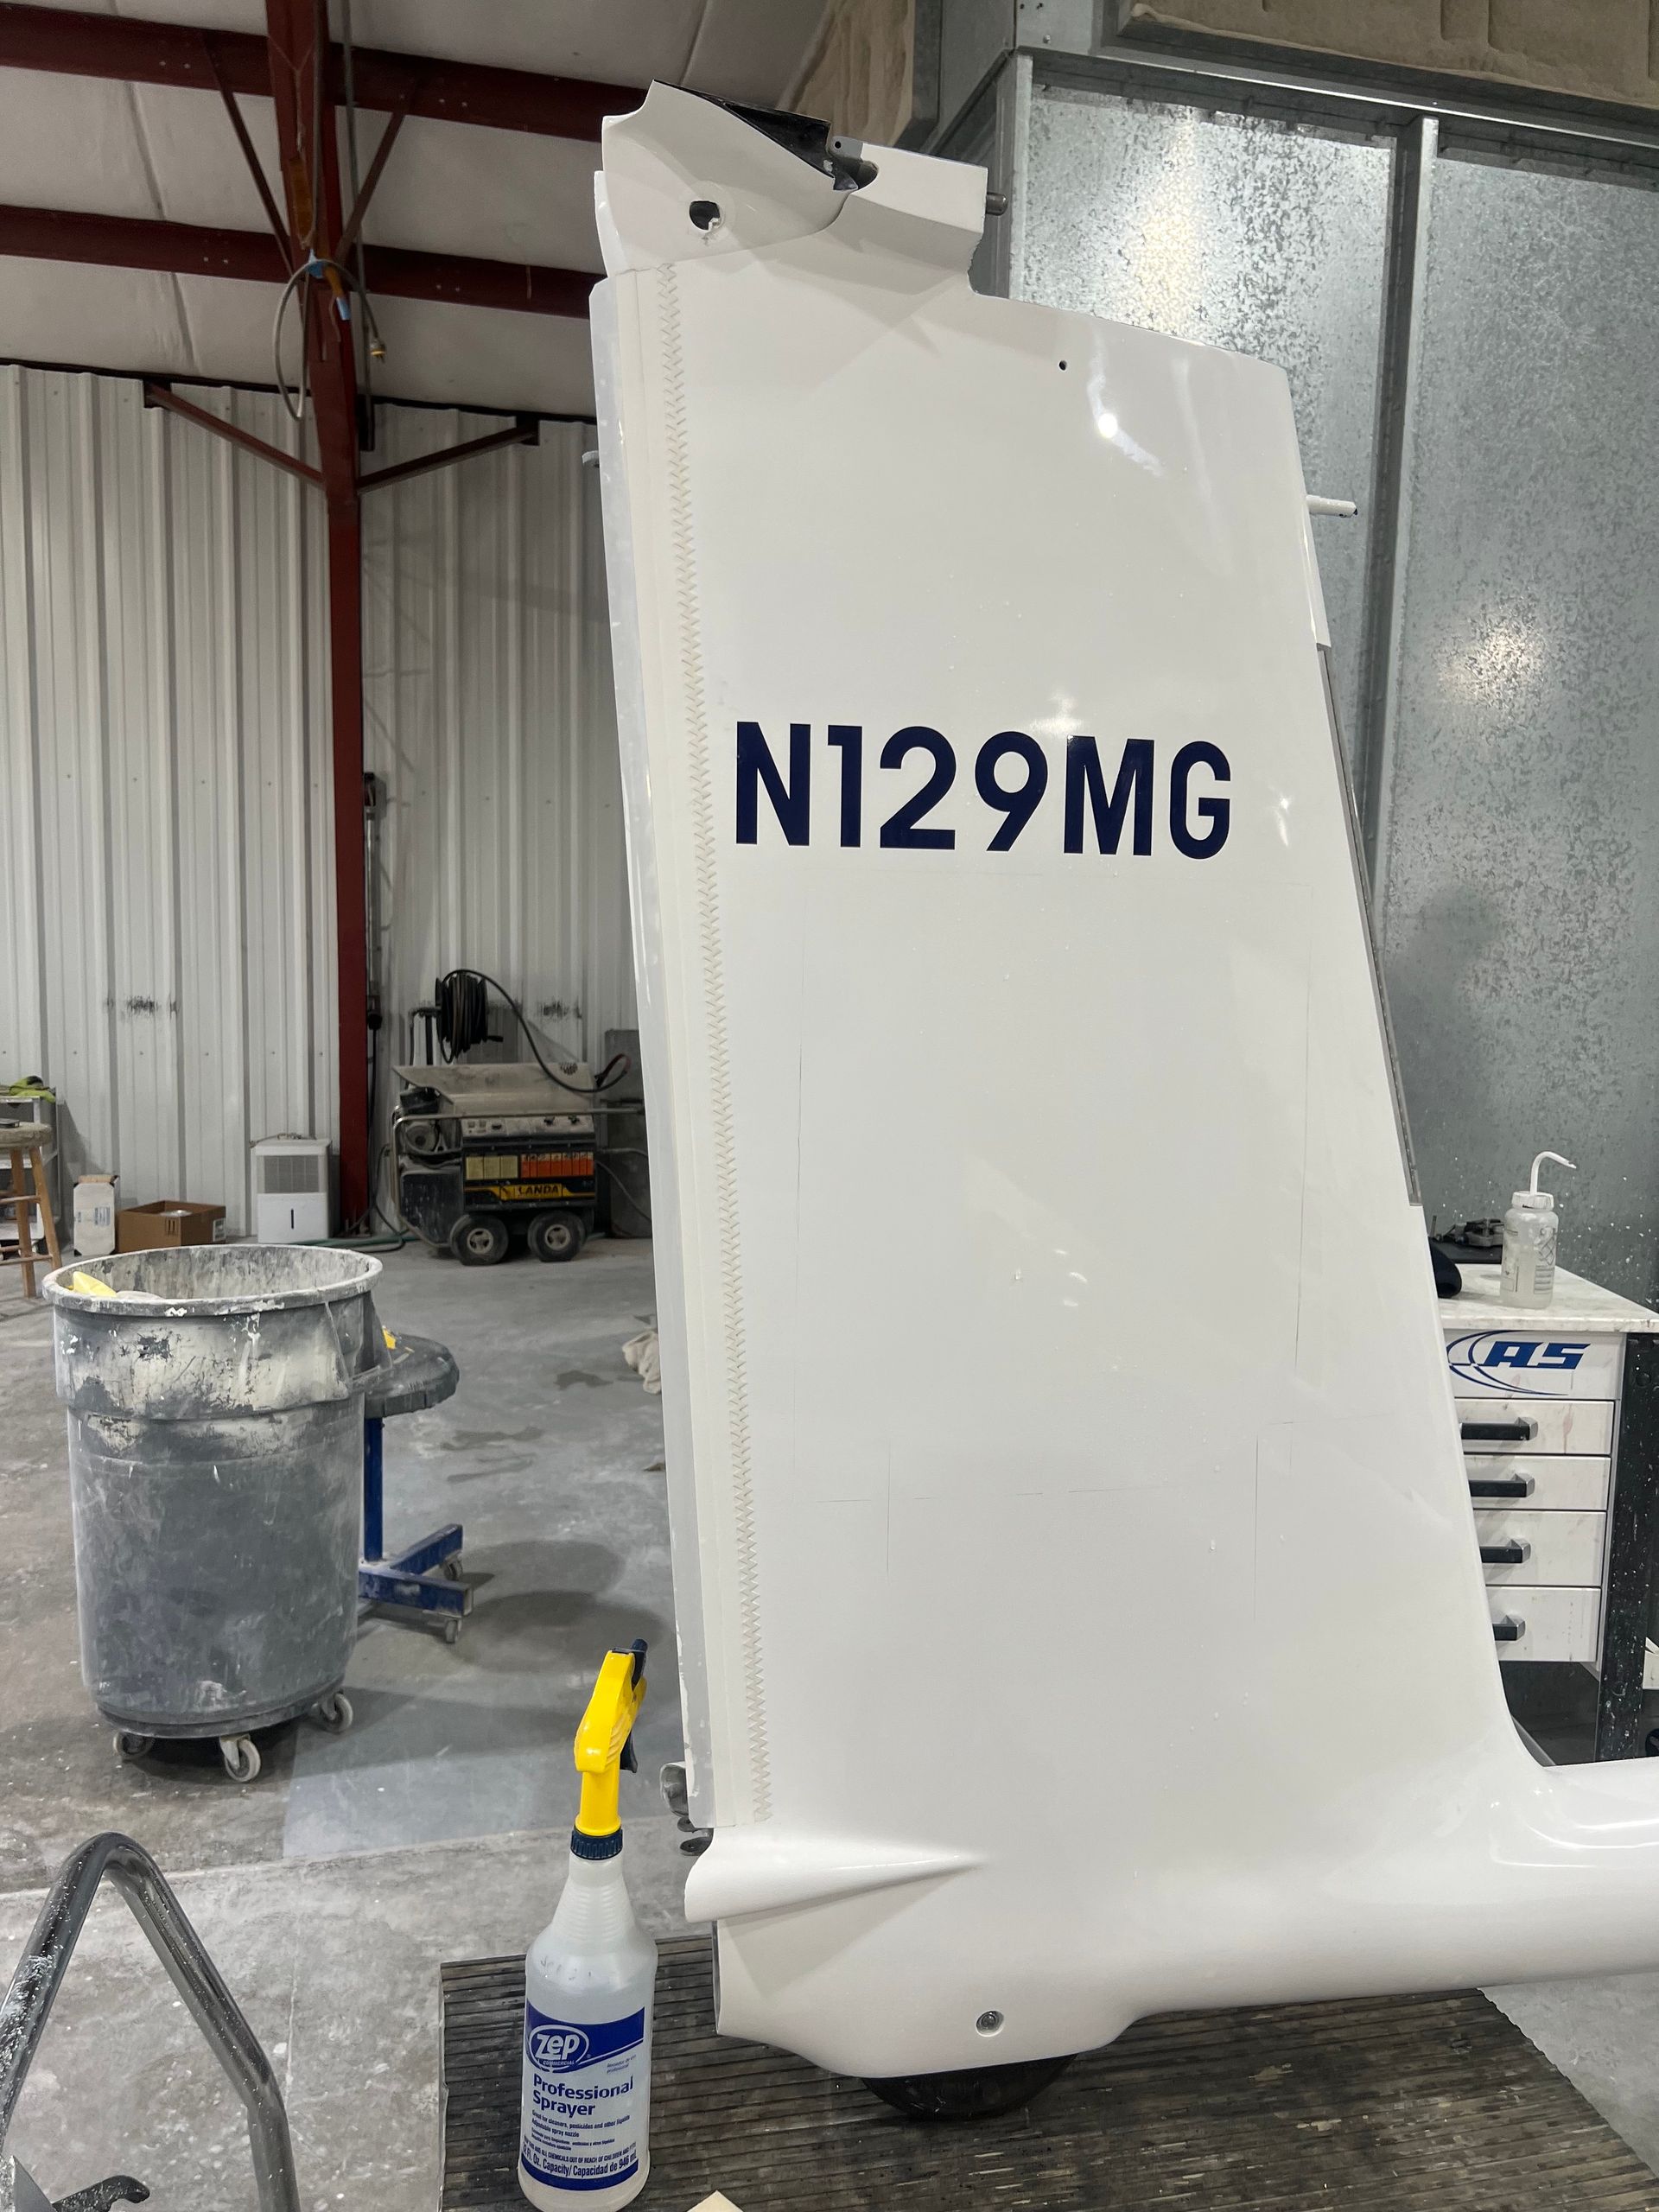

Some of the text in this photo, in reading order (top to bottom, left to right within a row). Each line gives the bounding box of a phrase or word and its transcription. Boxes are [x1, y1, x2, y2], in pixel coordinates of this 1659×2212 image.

[736, 721, 1231, 860] N129MG
[518, 1185, 559, 1195] LANDA
[533, 2073, 634, 2101] Professional
[532, 2090, 596, 2119] Sprayer
[551, 2128, 564, 2137] spray
[573, 2163, 608, 2178] Capacidad
[610, 2162, 618, 2172] de
[619, 2155, 630, 2170] 946
